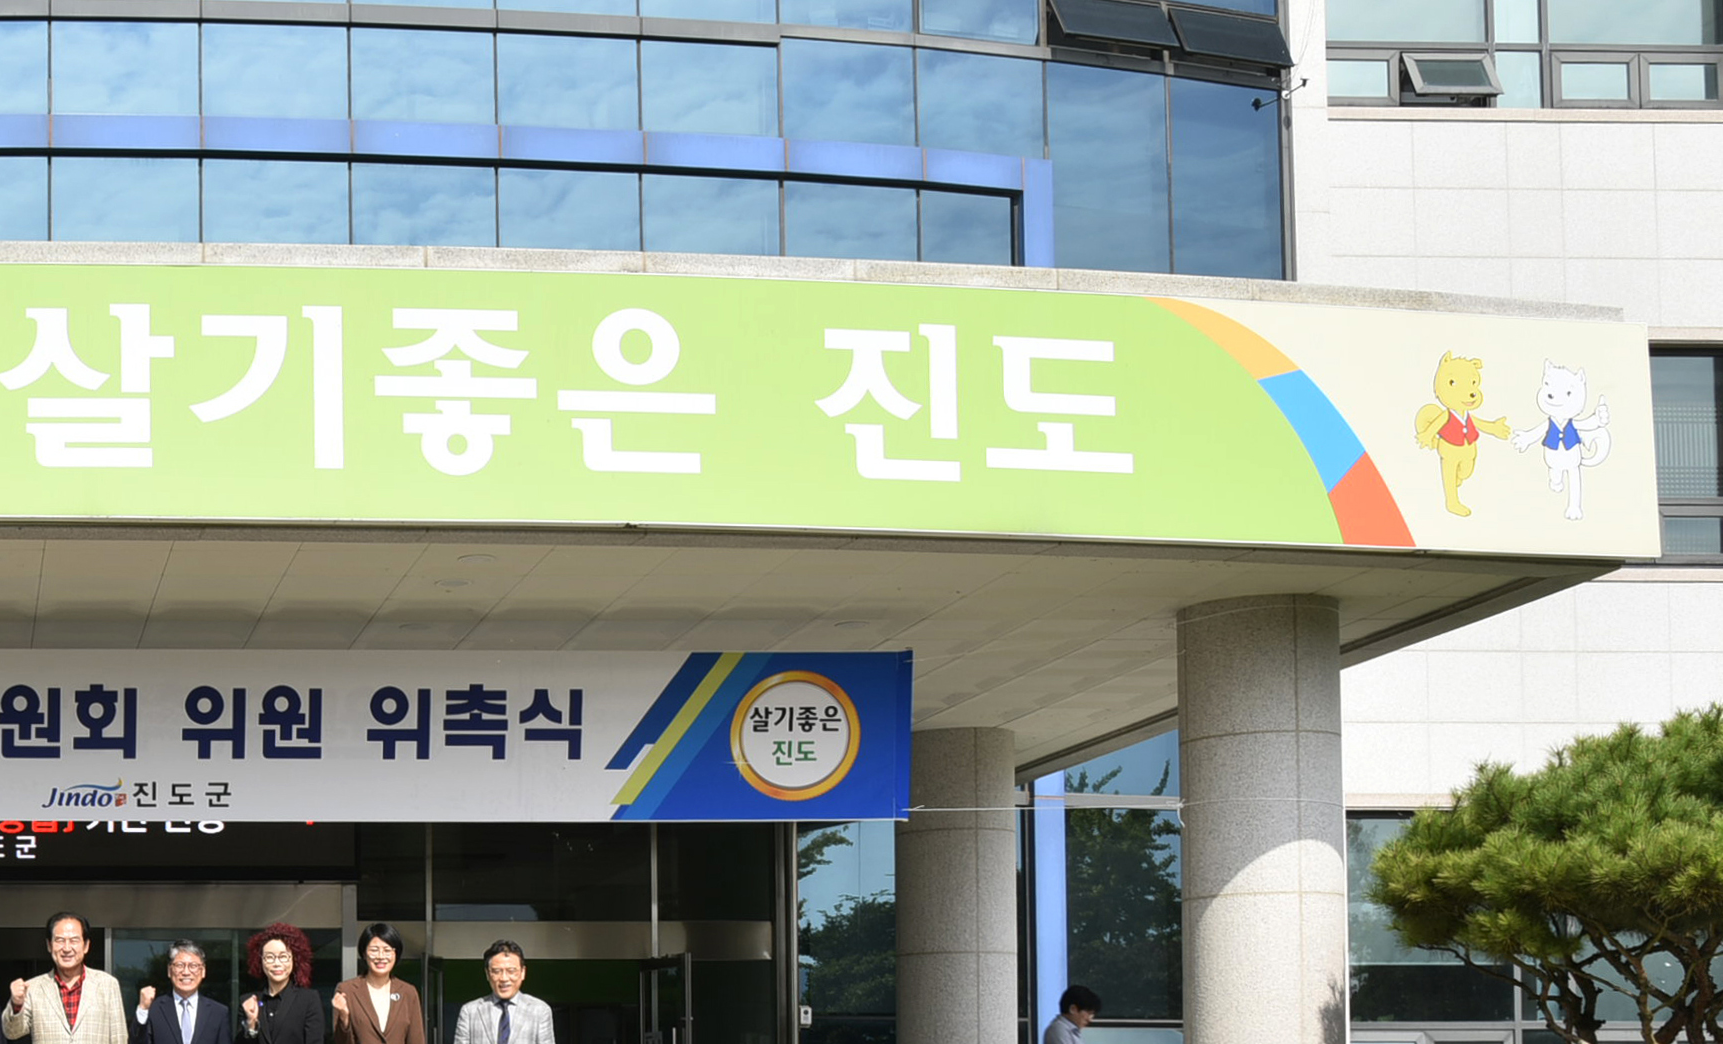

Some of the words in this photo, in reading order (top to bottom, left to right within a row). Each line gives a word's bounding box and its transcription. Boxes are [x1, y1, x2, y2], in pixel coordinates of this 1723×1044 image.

[814, 323, 1134, 482] 진도
[181, 684, 323, 760] 위원
[366, 683, 584, 760] 위촉식
[749, 705, 842, 733] 살기좋은
[772, 740, 817, 766] 진도
[41, 787, 113, 808] Jindo
